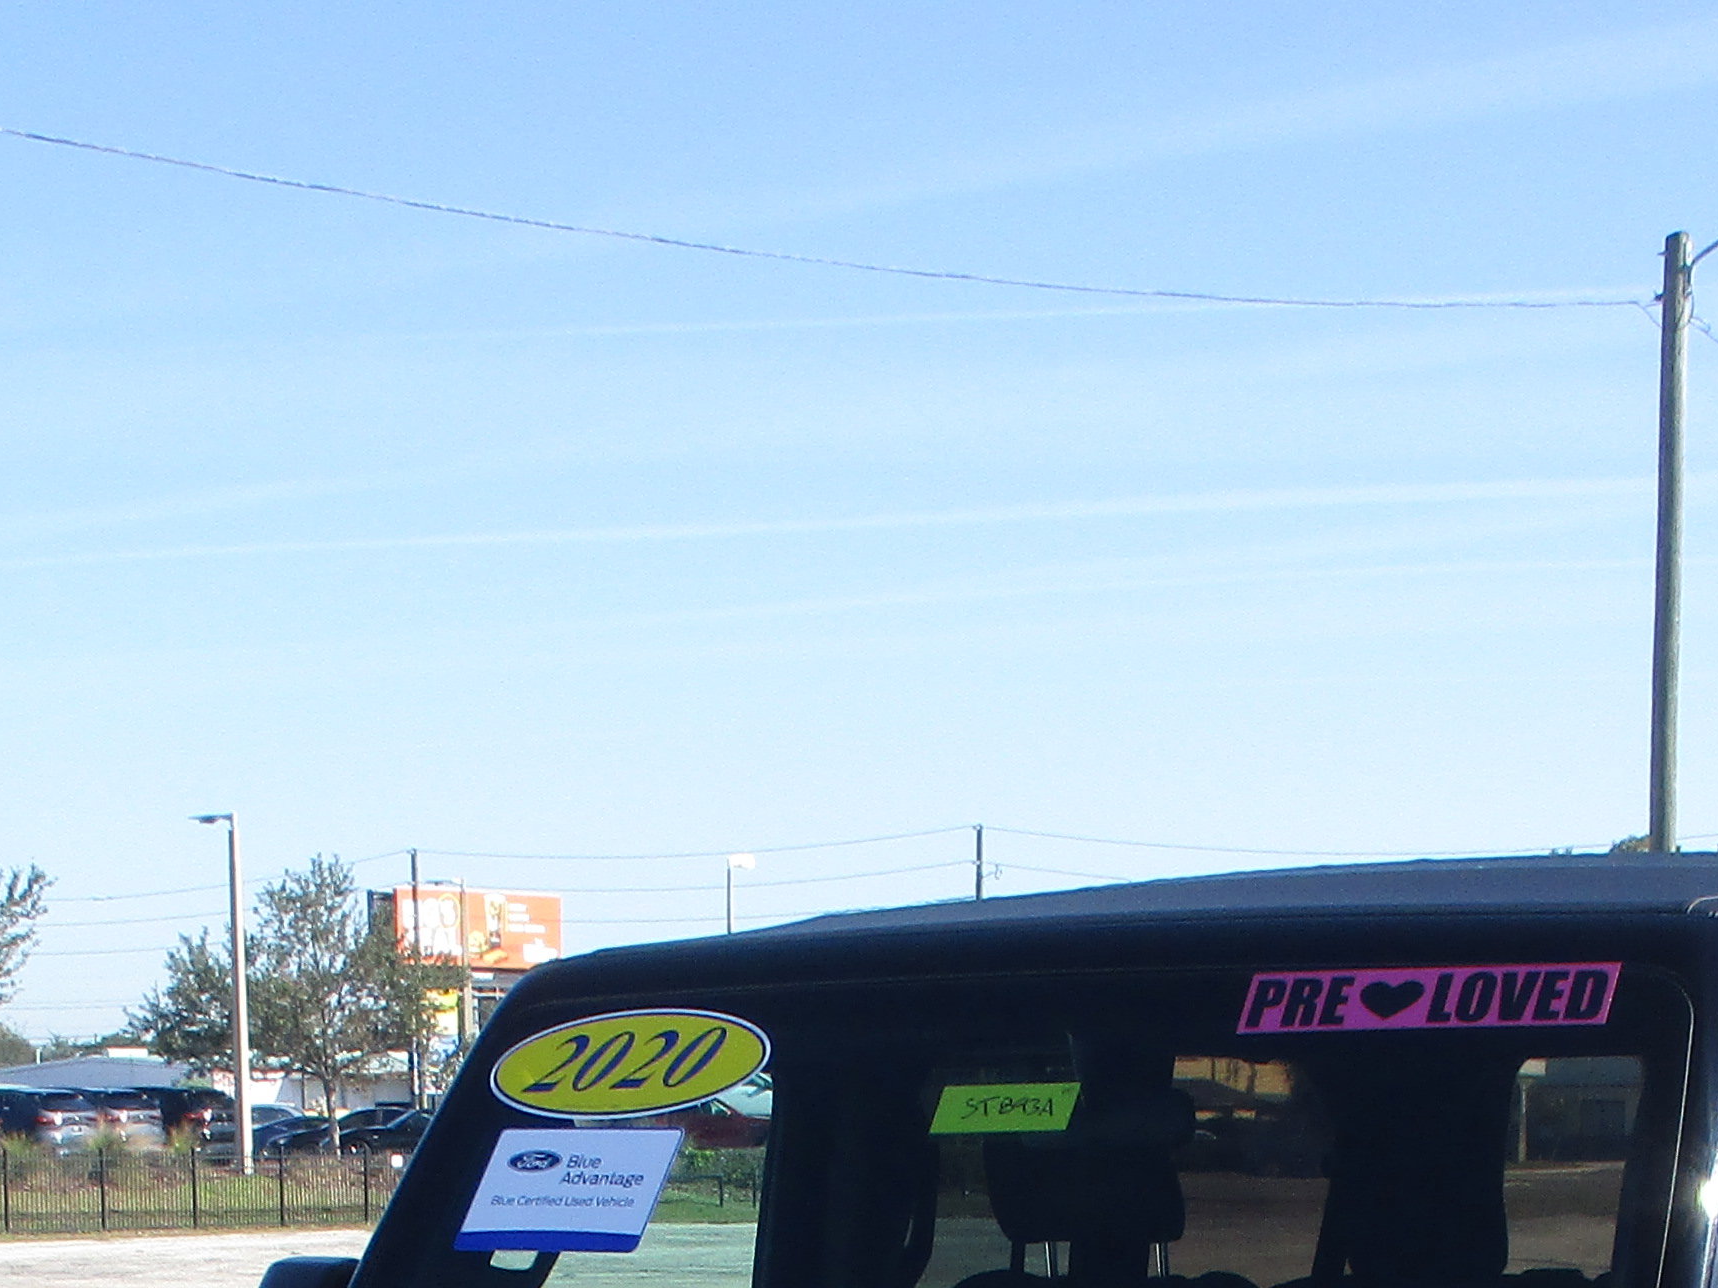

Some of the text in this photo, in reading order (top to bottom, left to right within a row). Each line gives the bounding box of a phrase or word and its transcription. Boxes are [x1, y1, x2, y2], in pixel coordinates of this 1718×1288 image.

[1244, 969, 1610, 1029] PRE LOVED
[520, 1025, 728, 1094] 2020
[559, 1172, 645, 1188] Advantage
[566, 1154, 602, 1169] Blue
